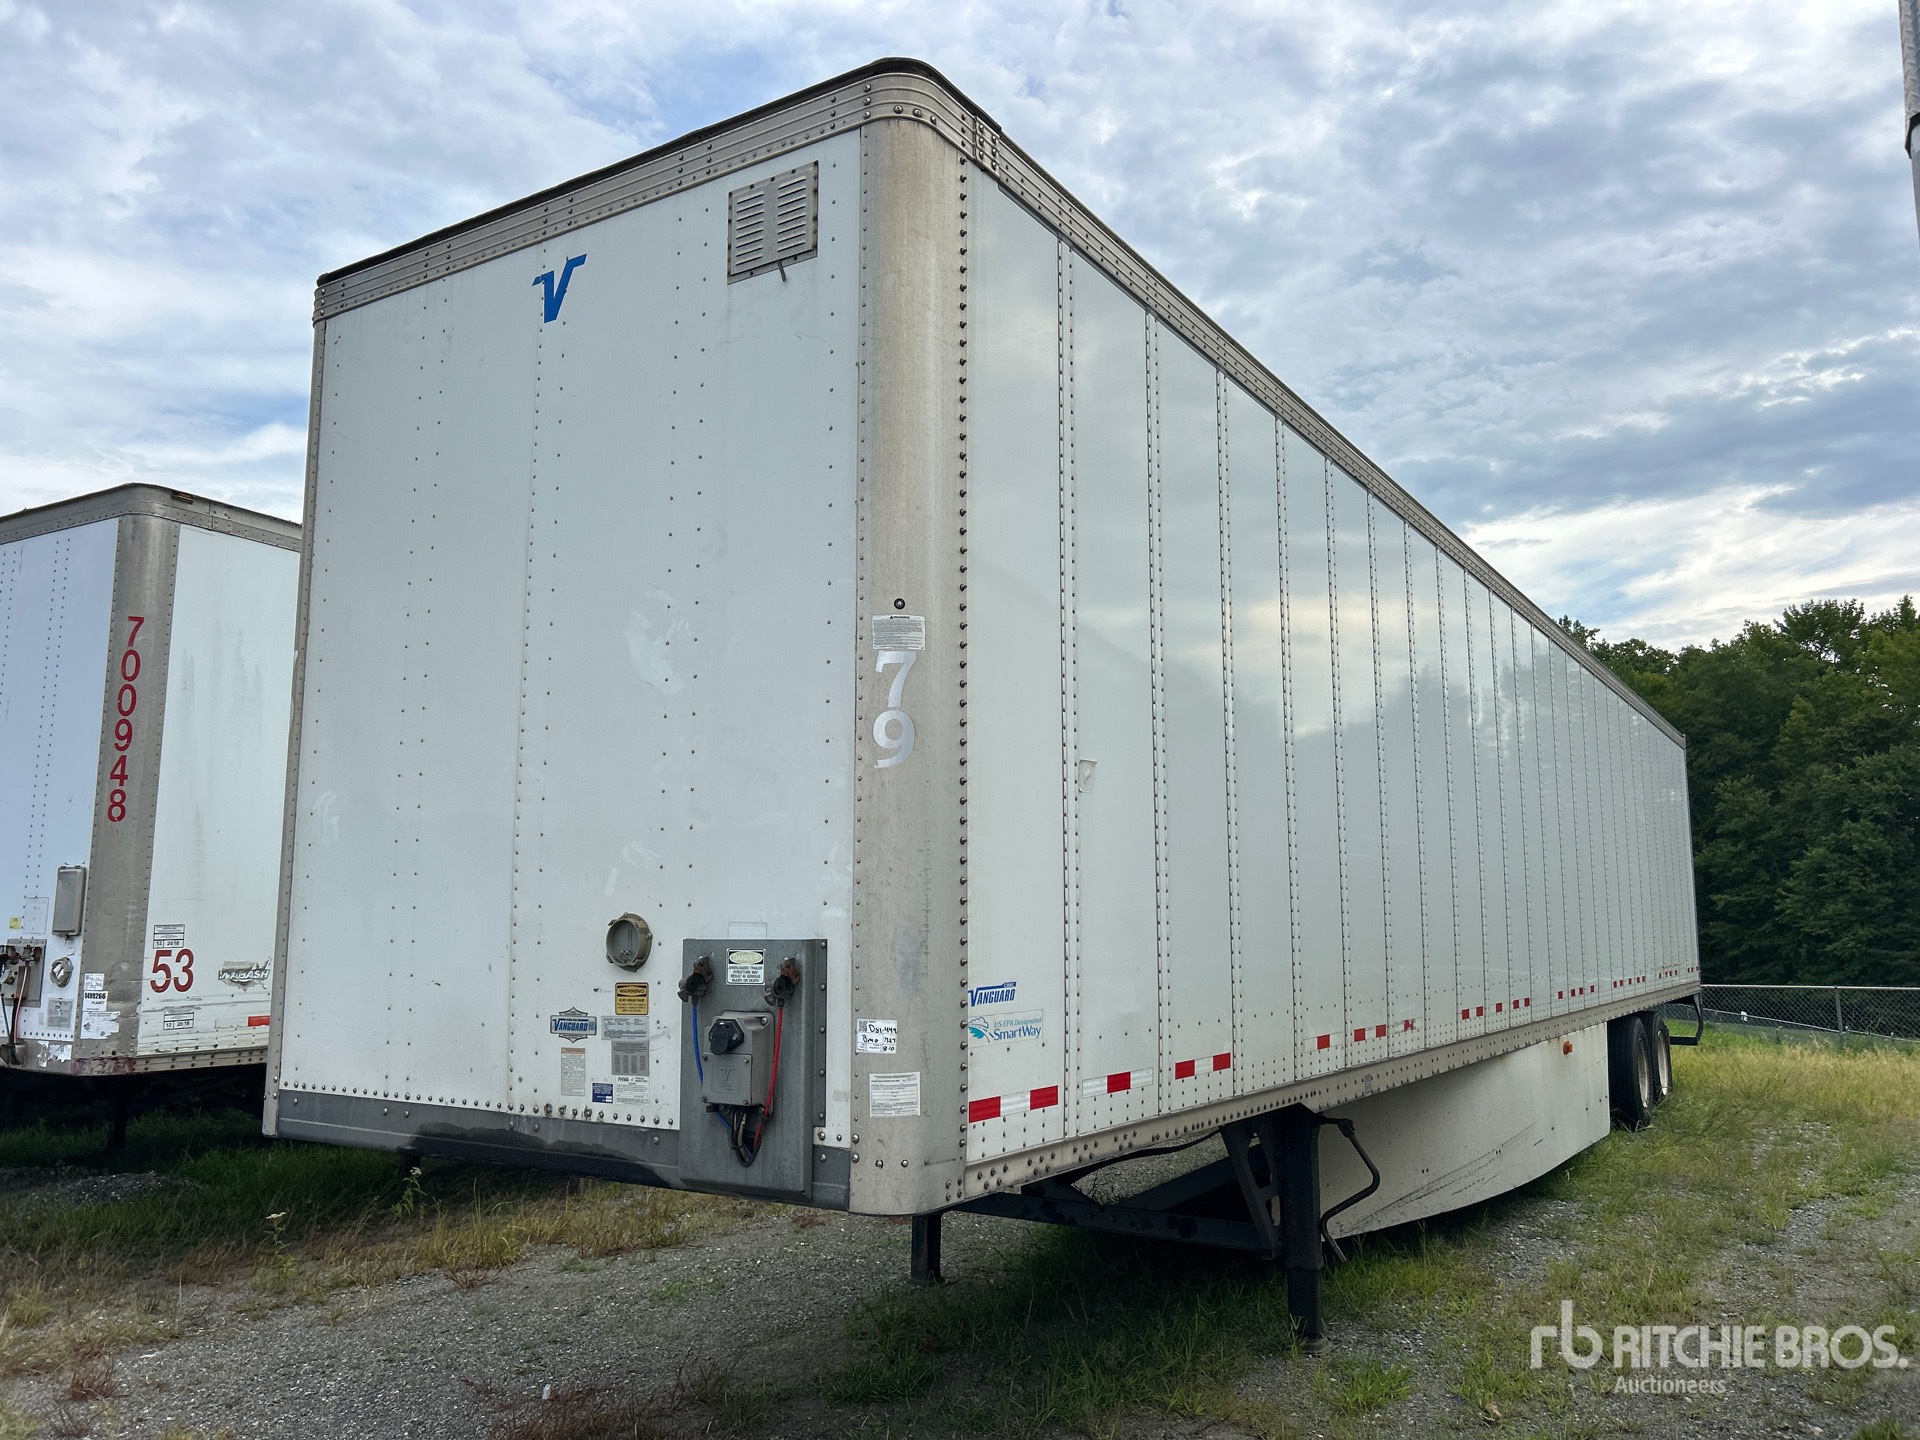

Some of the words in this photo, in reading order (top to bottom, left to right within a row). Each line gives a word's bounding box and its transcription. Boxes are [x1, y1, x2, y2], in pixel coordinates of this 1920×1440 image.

[108, 616, 145, 822] 700948
[866, 650, 917, 769] 79
[150, 948, 195, 994] 53
[967, 987, 1016, 1007] VANGUARD
[552, 1018, 589, 1032] VANGUARD
[993, 1025, 1042, 1041] SmartWay
[994, 1020, 1002, 1028] US
[1003, 1019, 1014, 1027] EPA
